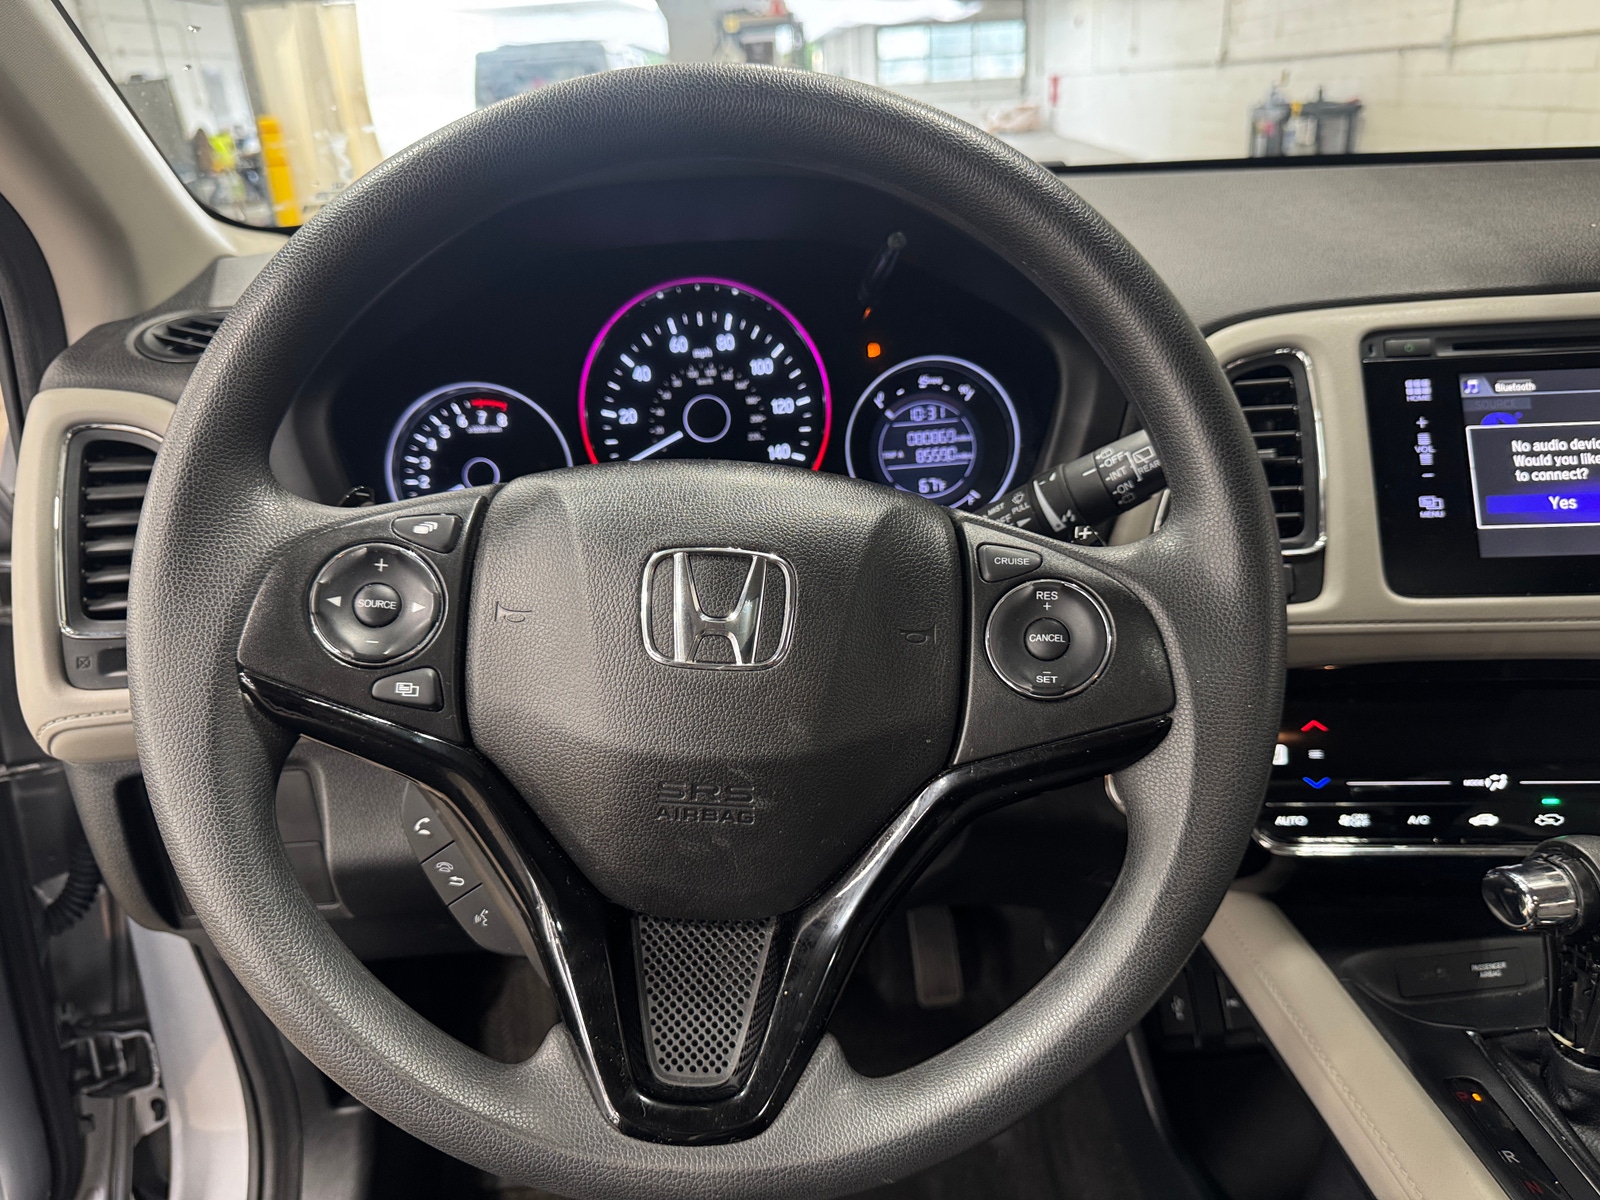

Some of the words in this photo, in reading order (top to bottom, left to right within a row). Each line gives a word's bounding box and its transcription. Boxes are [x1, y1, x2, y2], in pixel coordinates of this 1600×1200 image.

[669, 335, 689, 354] 60
[715, 332, 736, 352] 80
[632, 364, 652, 383] 40
[749, 357, 774, 376] 100
[1494, 380, 1537, 393] Bluetooth
[771, 396, 795, 415] 120
[1475, 399, 1518, 410] SOURCE
[455, 413, 469, 429] 6
[475, 409, 489, 426] 7
[495, 411, 509, 428] 8
[618, 406, 639, 425] 20
[438, 423, 452, 439] 5
[425, 436, 439, 452] 4
[767, 443, 791, 461] 140
[1511, 439, 1532, 453] No
[1532, 438, 1569, 452] audio
[418, 455, 432, 471] 3
[1103, 451, 1125, 468] OFF
[1137, 459, 1161, 475] REAR
[1512, 453, 1554, 468] Would
[1553, 454, 1579, 468] you
[1109, 465, 1127, 482] INT
[1515, 469, 1531, 482] to
[1531, 467, 1590, 482] connect?
[417, 474, 431, 490] 2
[1116, 479, 1135, 495] ON
[987, 501, 1005, 517] MIST
[1011, 502, 1031, 515] PULL
[1547, 495, 1579, 511] Yes
[993, 556, 1031, 567] CRUISE
[1035, 590, 1059, 601] RES
[357, 598, 398, 611] SOURCE
[1028, 633, 1067, 643] CANCEL
[1035, 675, 1058, 684] SET
[657, 781, 755, 803] SRS
[655, 806, 755, 824] AIRBAG
[1274, 815, 1309, 827] AUTO
[1407, 814, 1431, 826] A/C
[1502, 1150, 1520, 1164] R
